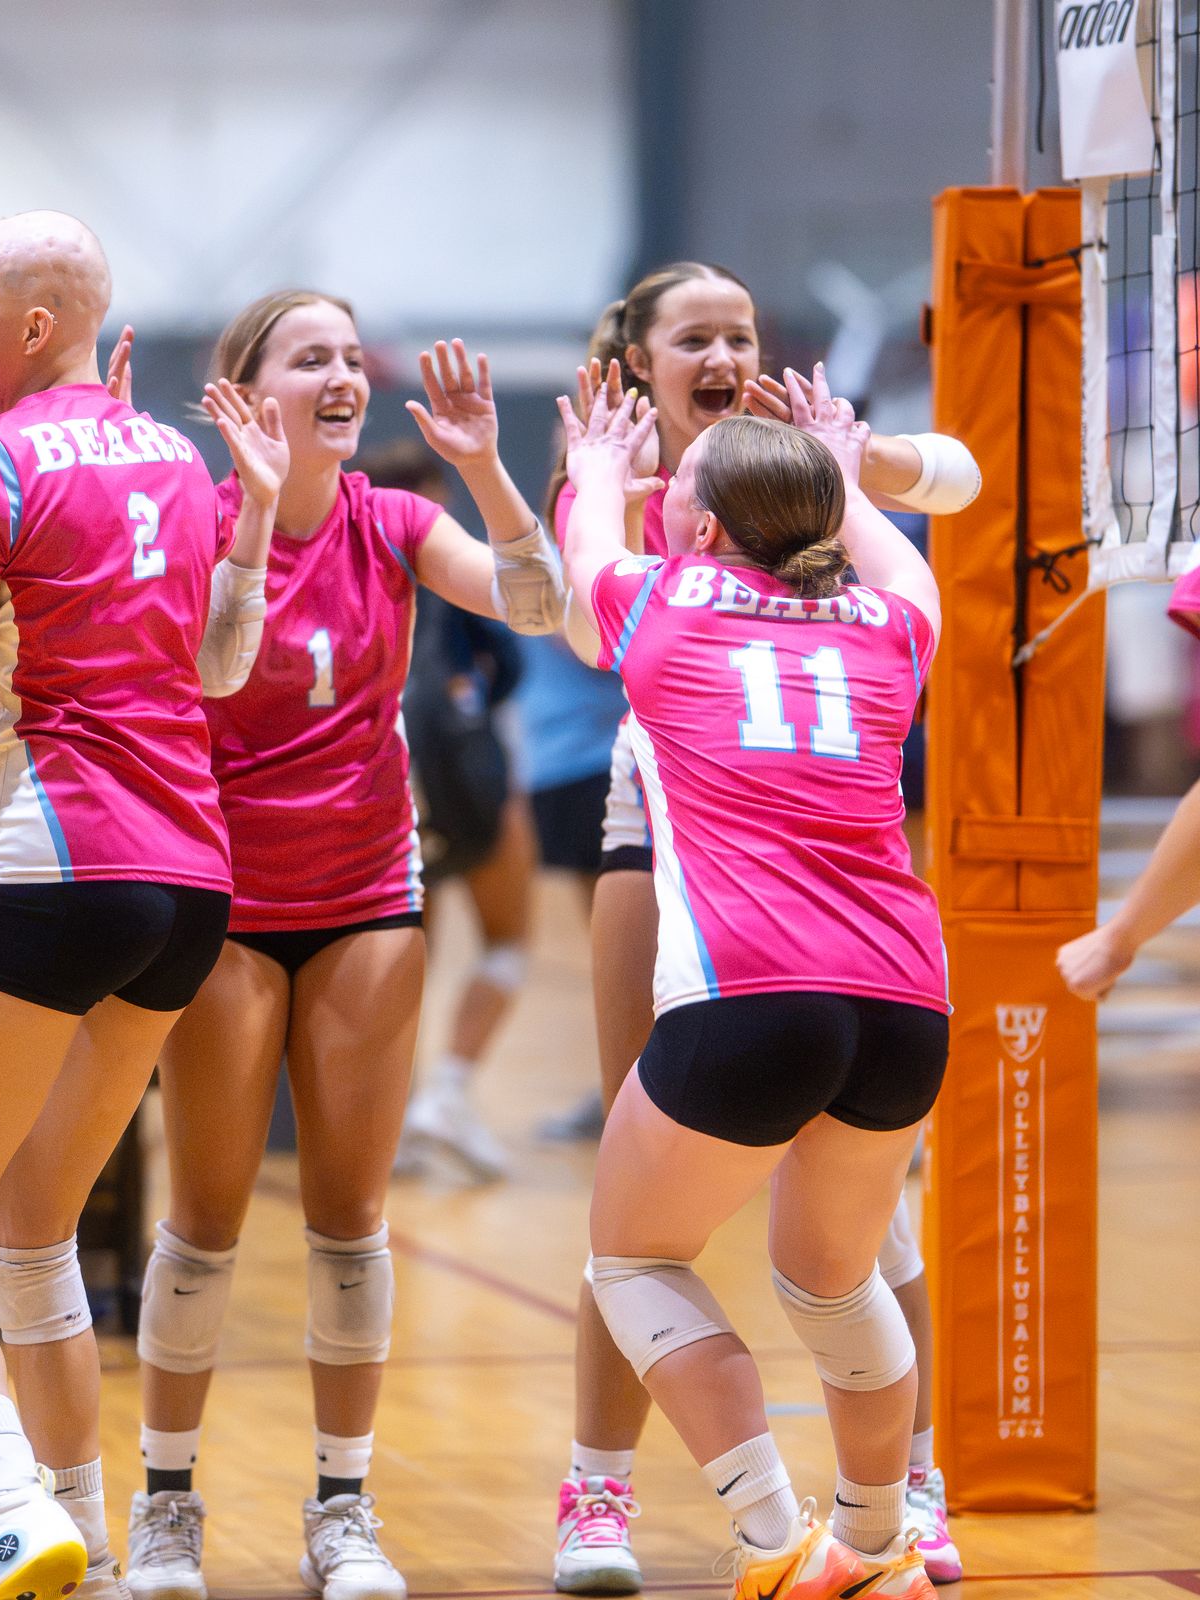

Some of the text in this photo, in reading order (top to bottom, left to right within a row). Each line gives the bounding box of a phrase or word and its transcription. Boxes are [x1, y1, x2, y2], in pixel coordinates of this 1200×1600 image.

[19, 416, 194, 475] BEARS
[127, 491, 166, 579] 2
[307, 627, 336, 708] 1
[728, 640, 860, 762] 11
